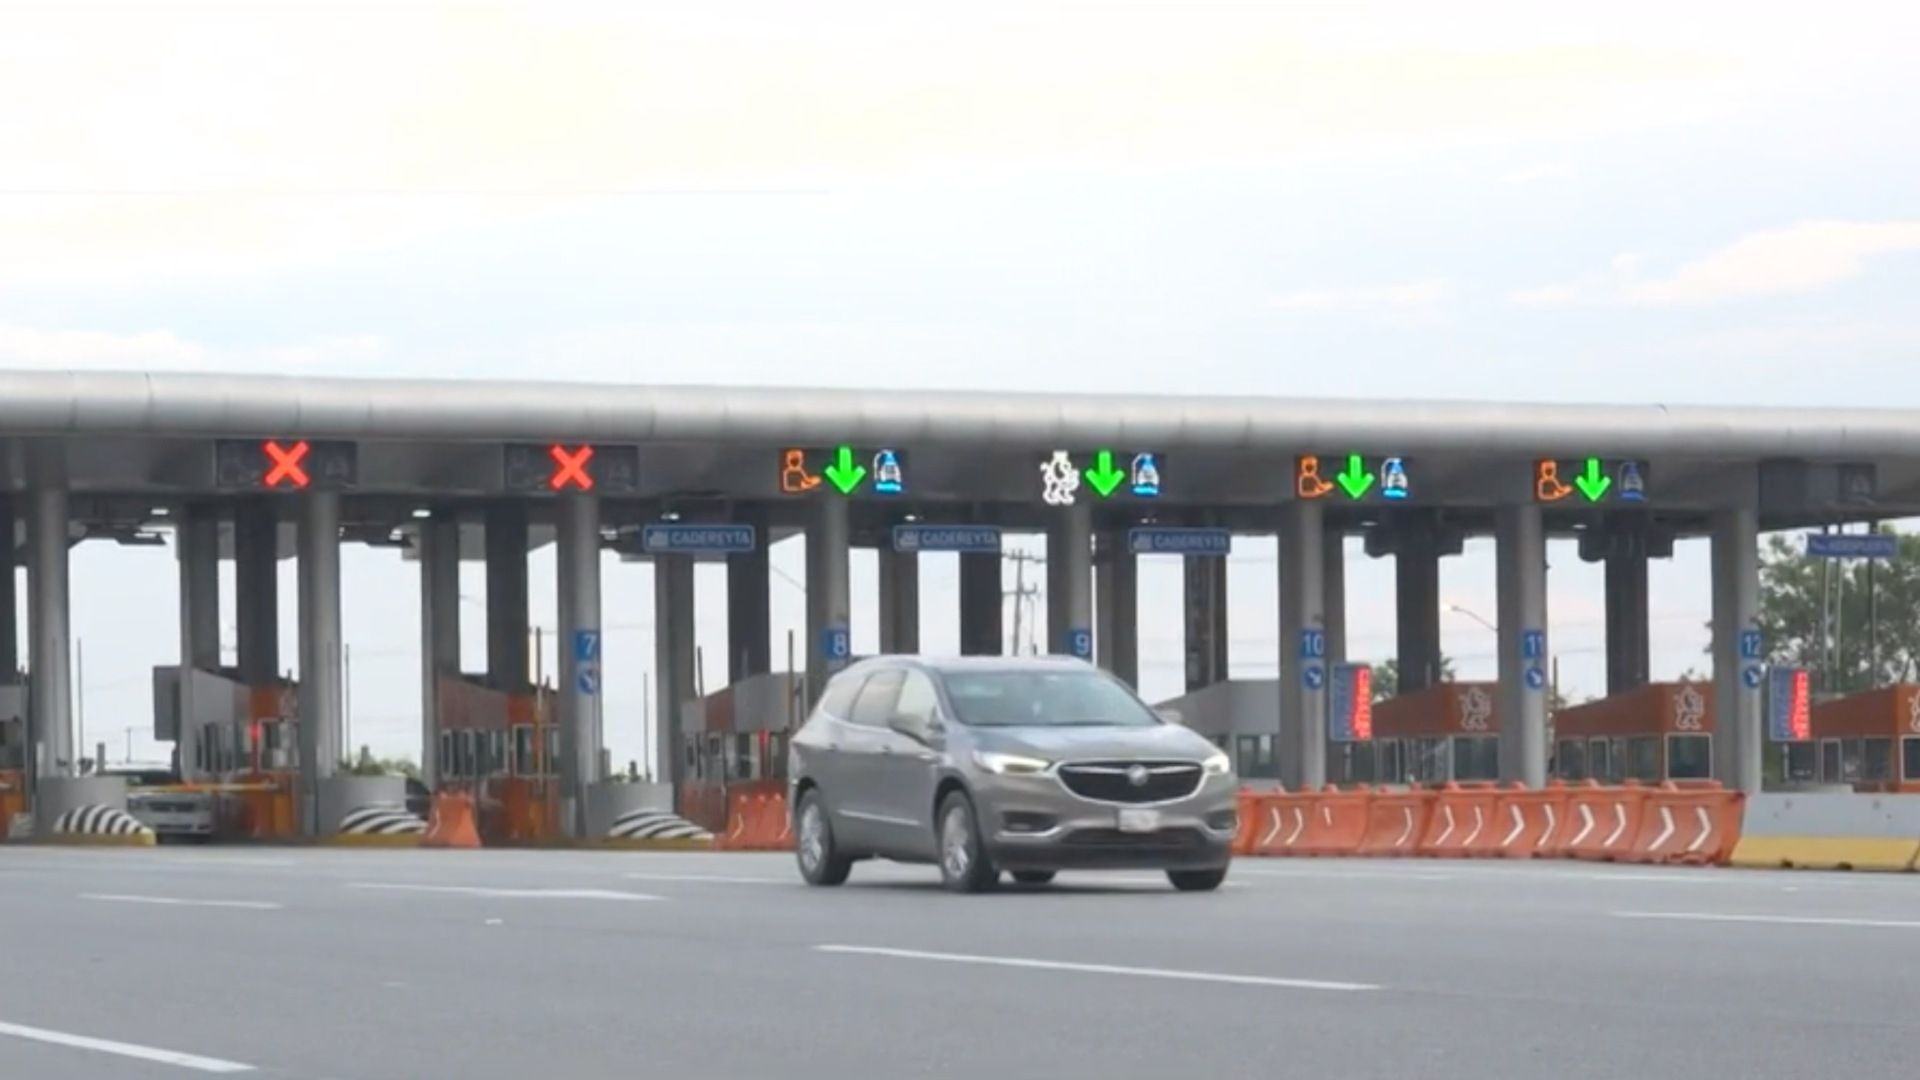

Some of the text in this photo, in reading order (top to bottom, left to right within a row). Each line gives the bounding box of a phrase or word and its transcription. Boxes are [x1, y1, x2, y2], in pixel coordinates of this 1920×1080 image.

[672, 530, 750, 545] CADEREYTA
[922, 530, 998, 545] CADEREYTA
[584, 633, 597, 655] 7
[833, 633, 847, 656] 8
[1075, 633, 1089, 656] 9
[1304, 633, 1324, 656] 10
[1527, 634, 1544, 656] 11
[1745, 634, 1761, 656] 12
